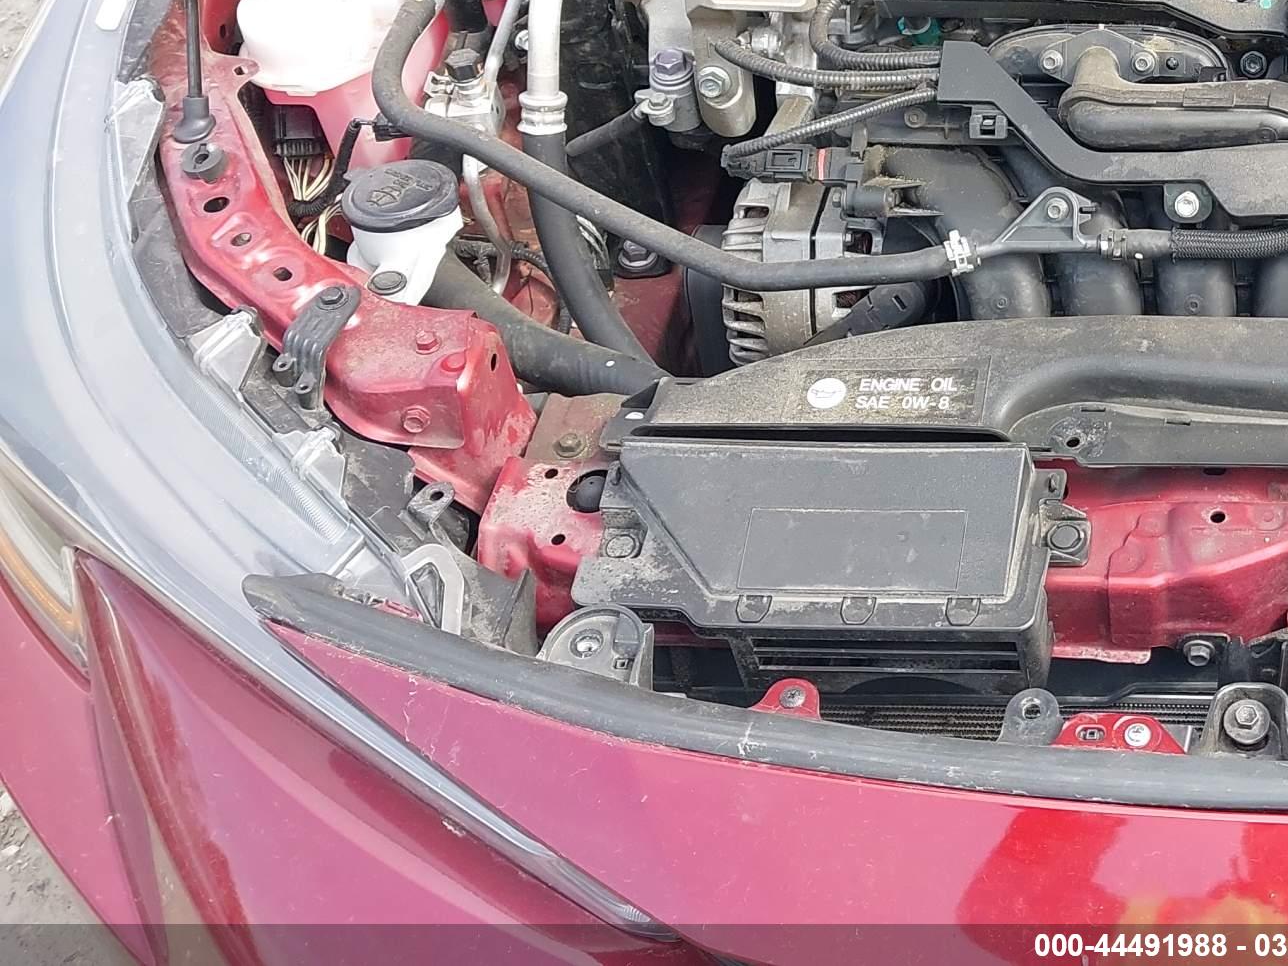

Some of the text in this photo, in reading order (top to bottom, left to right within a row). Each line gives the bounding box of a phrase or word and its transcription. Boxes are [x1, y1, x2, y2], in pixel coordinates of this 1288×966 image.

[859, 377, 958, 392] ENGINE OIL
[855, 396, 951, 410] SAE 0W-8
